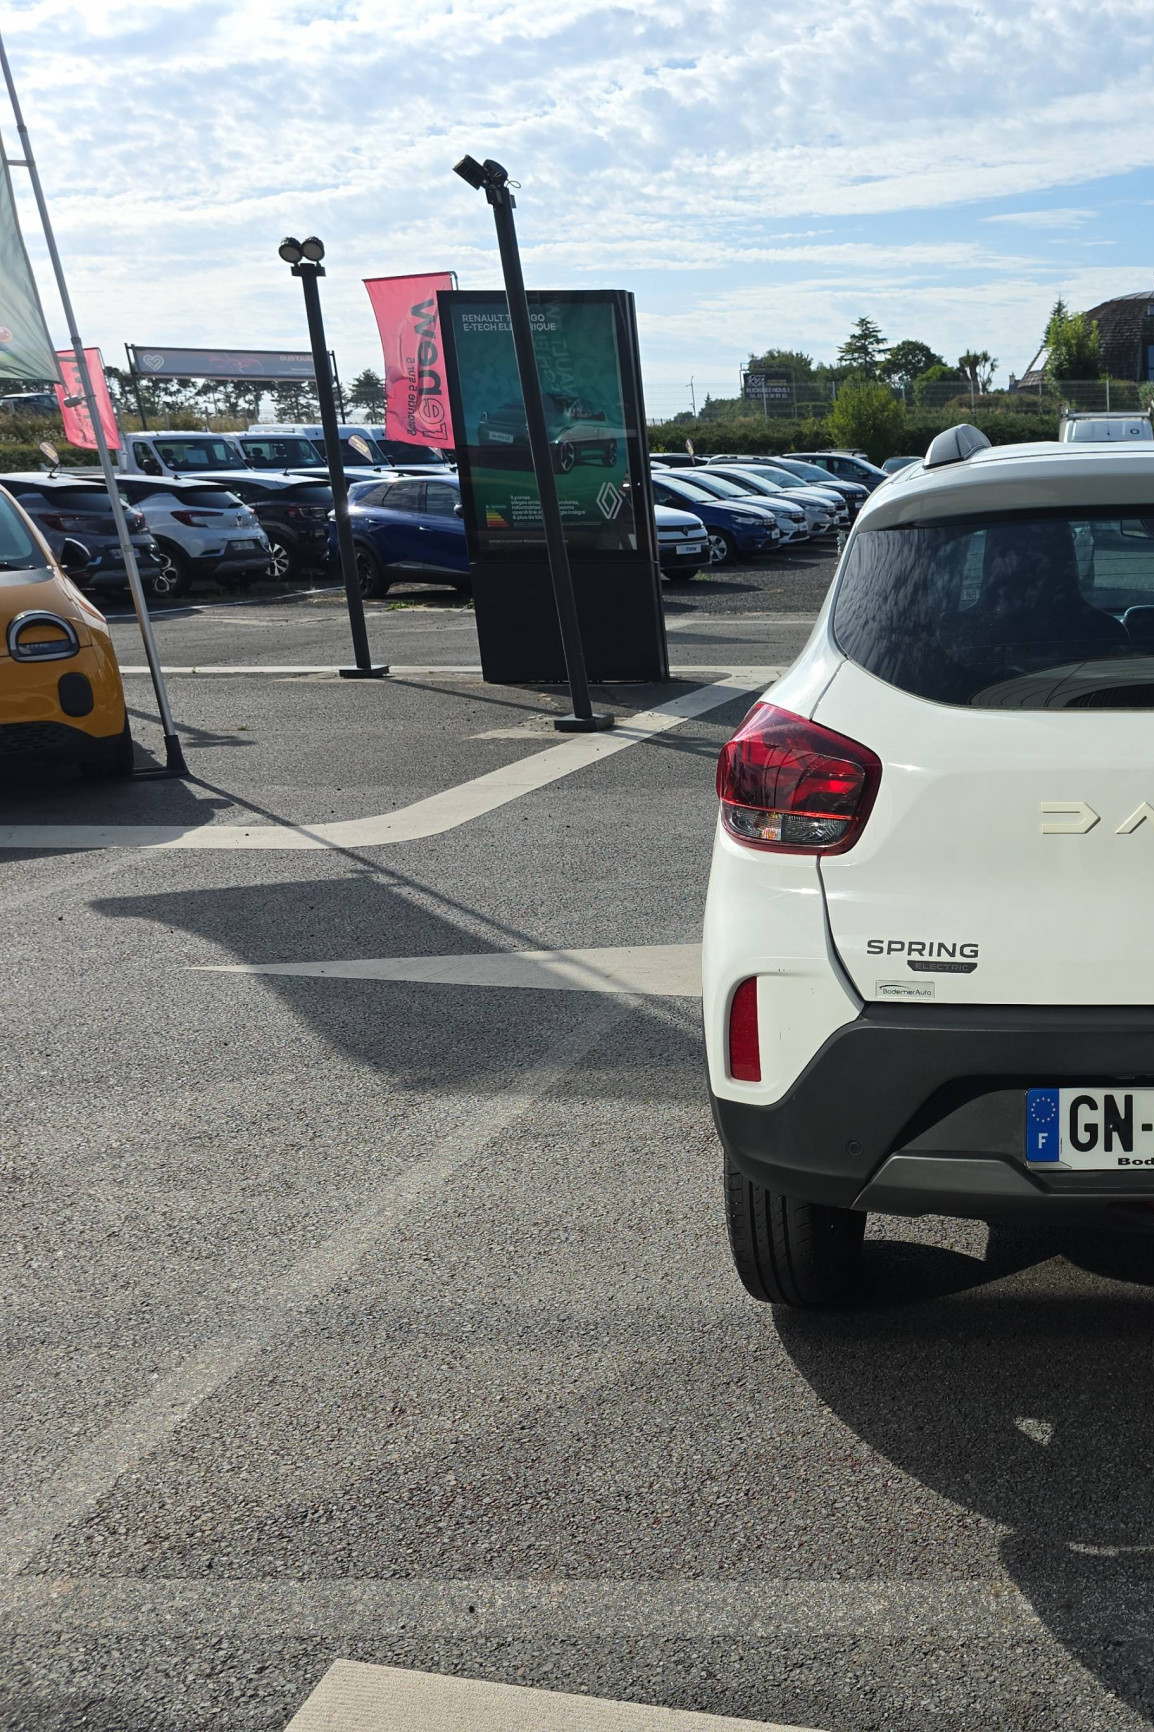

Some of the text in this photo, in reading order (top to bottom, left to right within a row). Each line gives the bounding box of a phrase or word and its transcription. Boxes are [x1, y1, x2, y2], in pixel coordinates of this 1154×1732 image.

[462, 314, 545, 322] RENAULT TGO
[463, 323, 497, 331] E-TECH
[867, 939, 979, 959] SPRING
[914, 961, 970, 971] ELECTRIC
[882, 987, 932, 996] BodemerAuto
[1038, 1132, 1049, 1150] F
